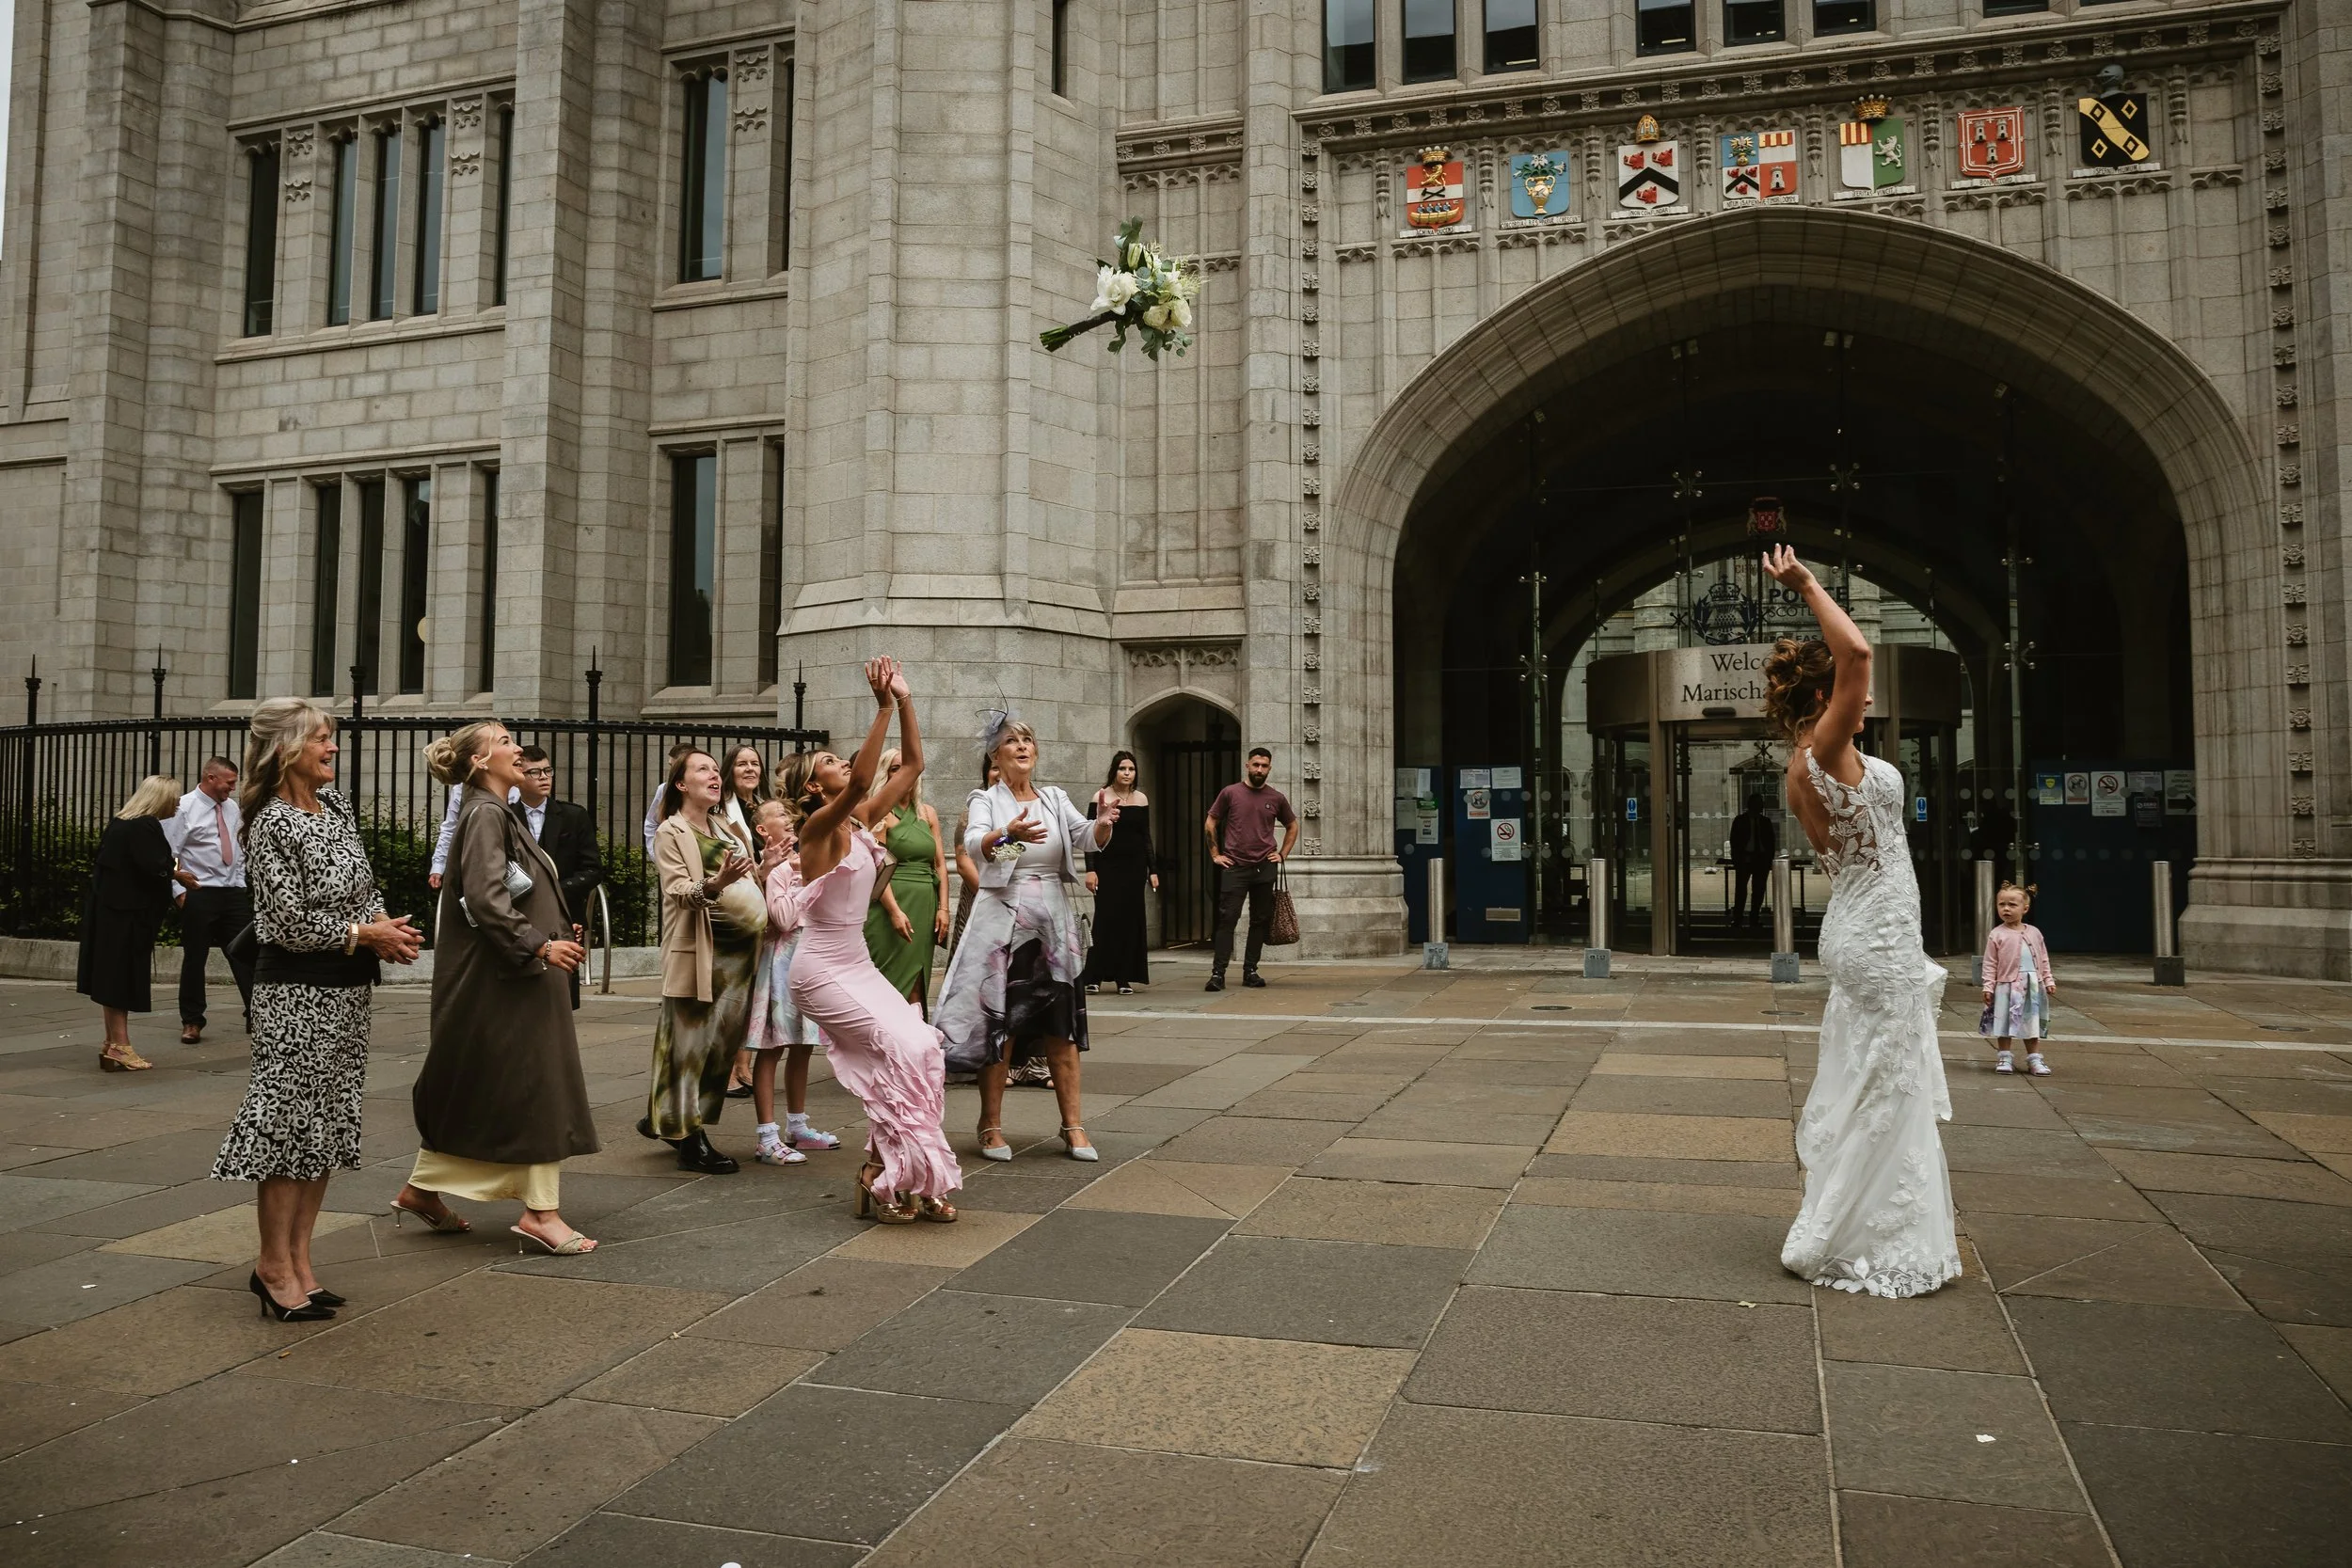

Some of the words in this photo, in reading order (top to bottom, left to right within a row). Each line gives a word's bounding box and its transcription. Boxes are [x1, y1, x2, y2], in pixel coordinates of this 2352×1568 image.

[1768, 606, 1818, 618] SCOTL
[1709, 651, 1772, 673] Welco
[1680, 680, 1767, 703] Marisch
